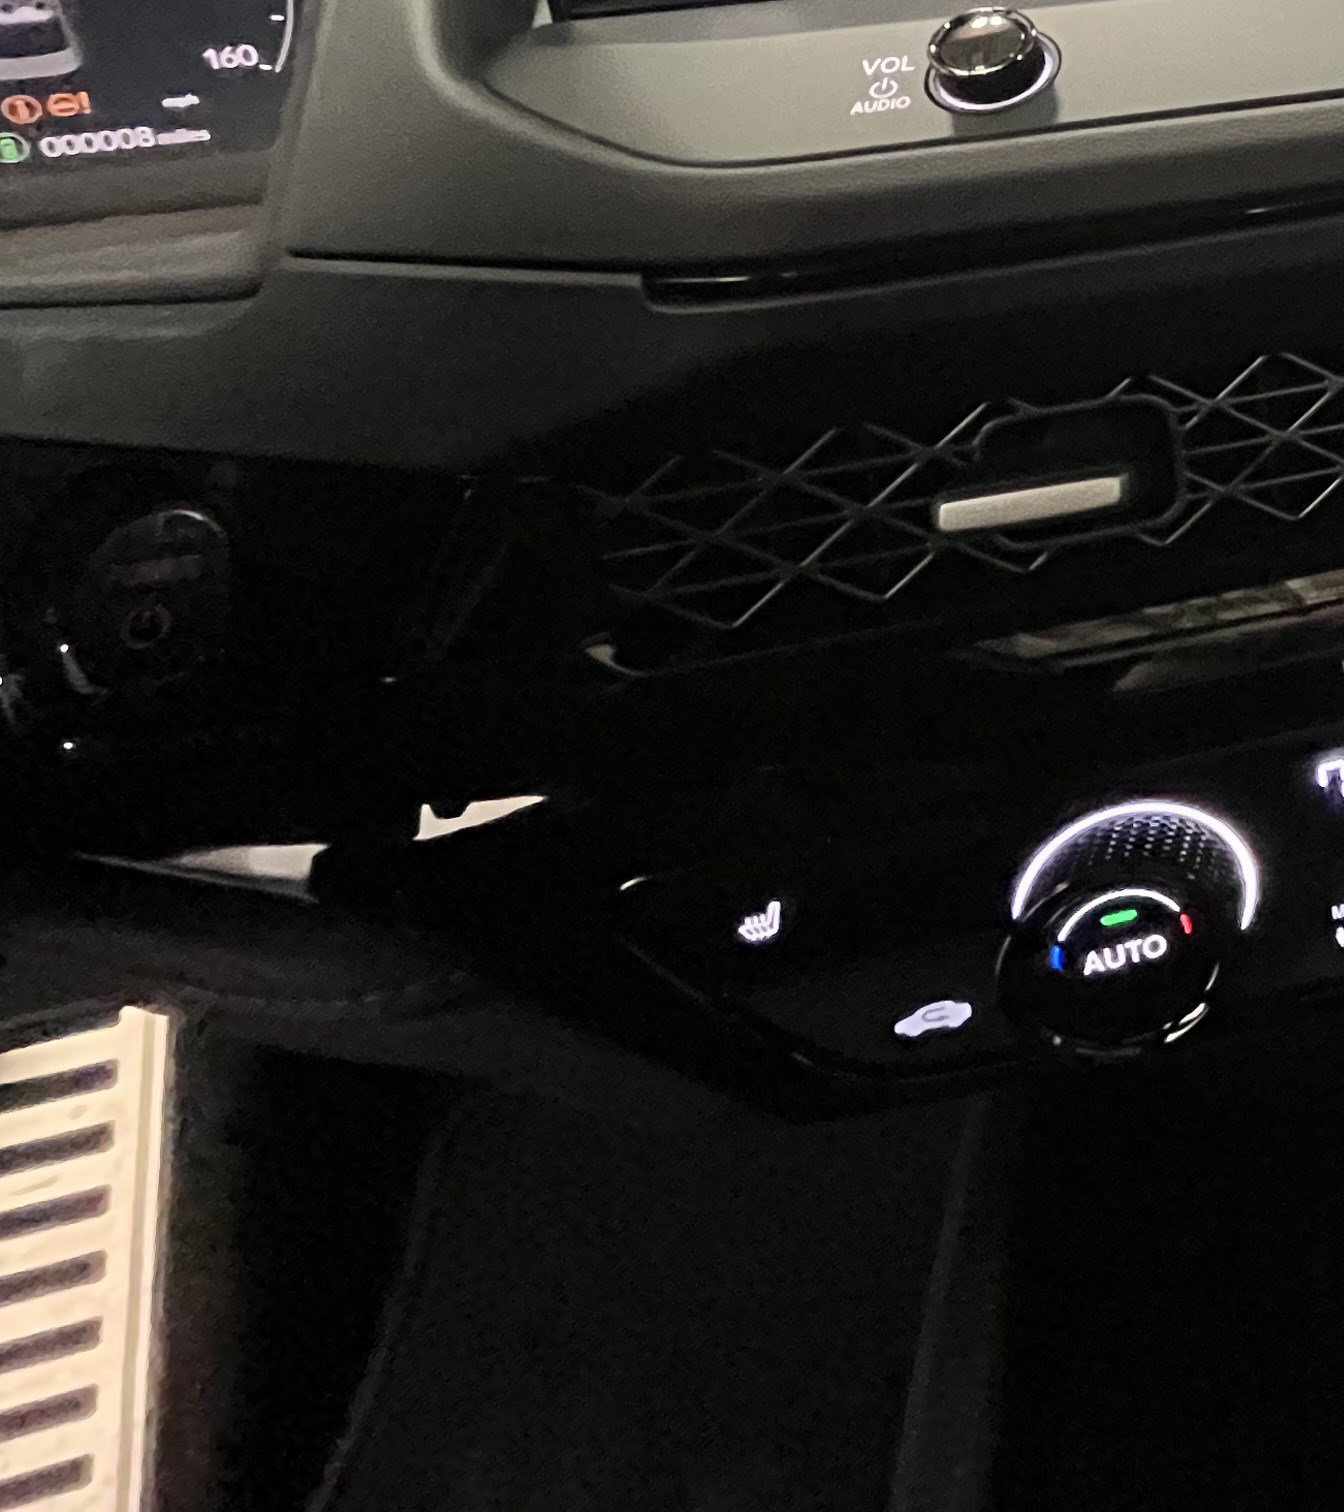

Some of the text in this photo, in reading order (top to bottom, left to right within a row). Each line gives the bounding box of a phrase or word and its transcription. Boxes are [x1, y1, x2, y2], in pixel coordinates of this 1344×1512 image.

[202, 44, 259, 71] 160
[862, 55, 916, 77] VOL
[850, 96, 911, 116] AUDIO
[1083, 934, 1168, 976] AUTO
